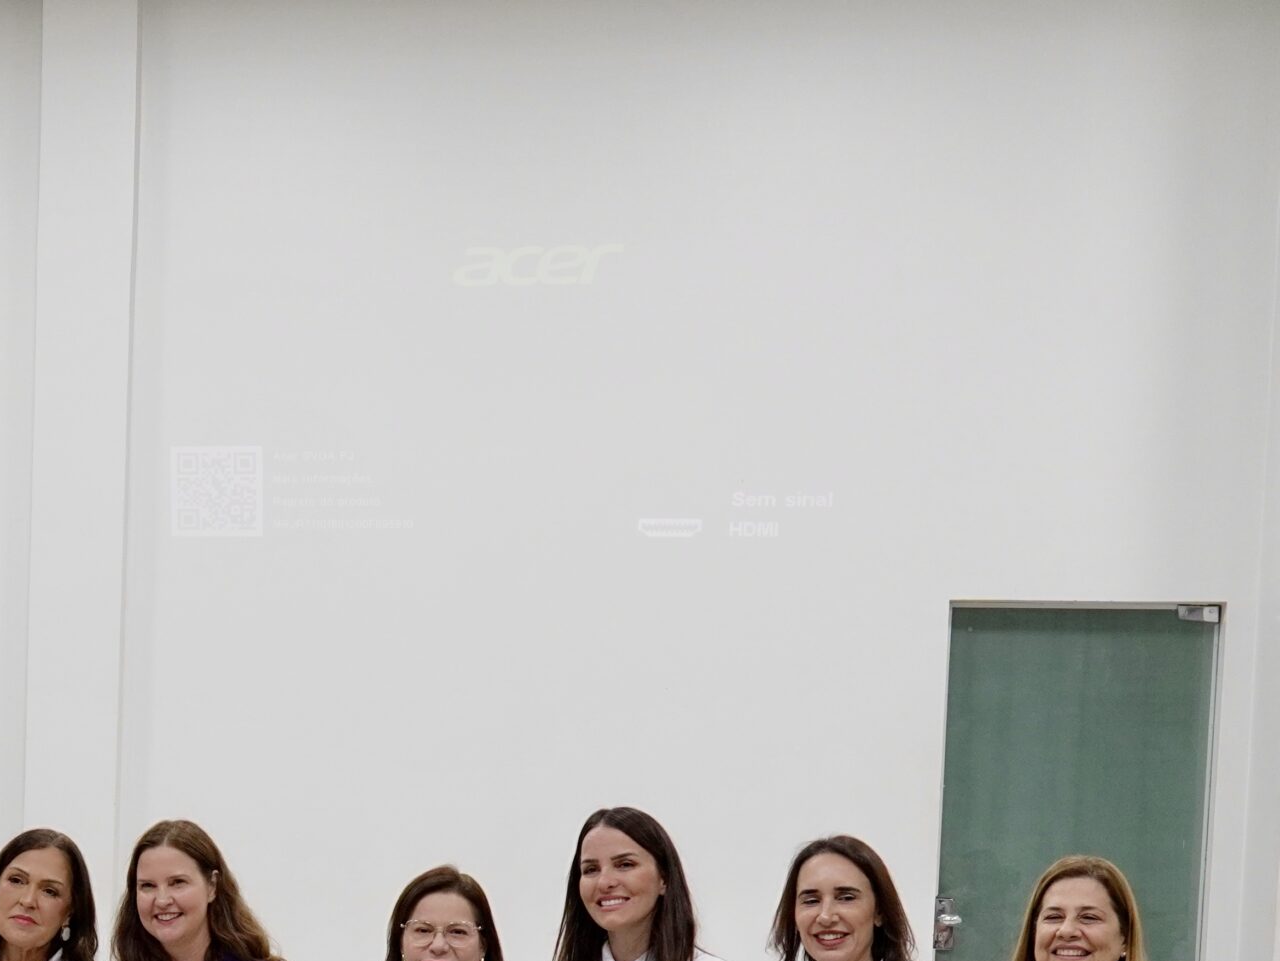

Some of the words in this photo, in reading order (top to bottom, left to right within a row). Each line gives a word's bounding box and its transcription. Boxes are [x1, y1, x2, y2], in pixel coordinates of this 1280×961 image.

[453, 243, 624, 286] acer
[731, 491, 777, 508] Sem
[784, 491, 834, 508] sinal
[728, 521, 779, 537] HDMI
